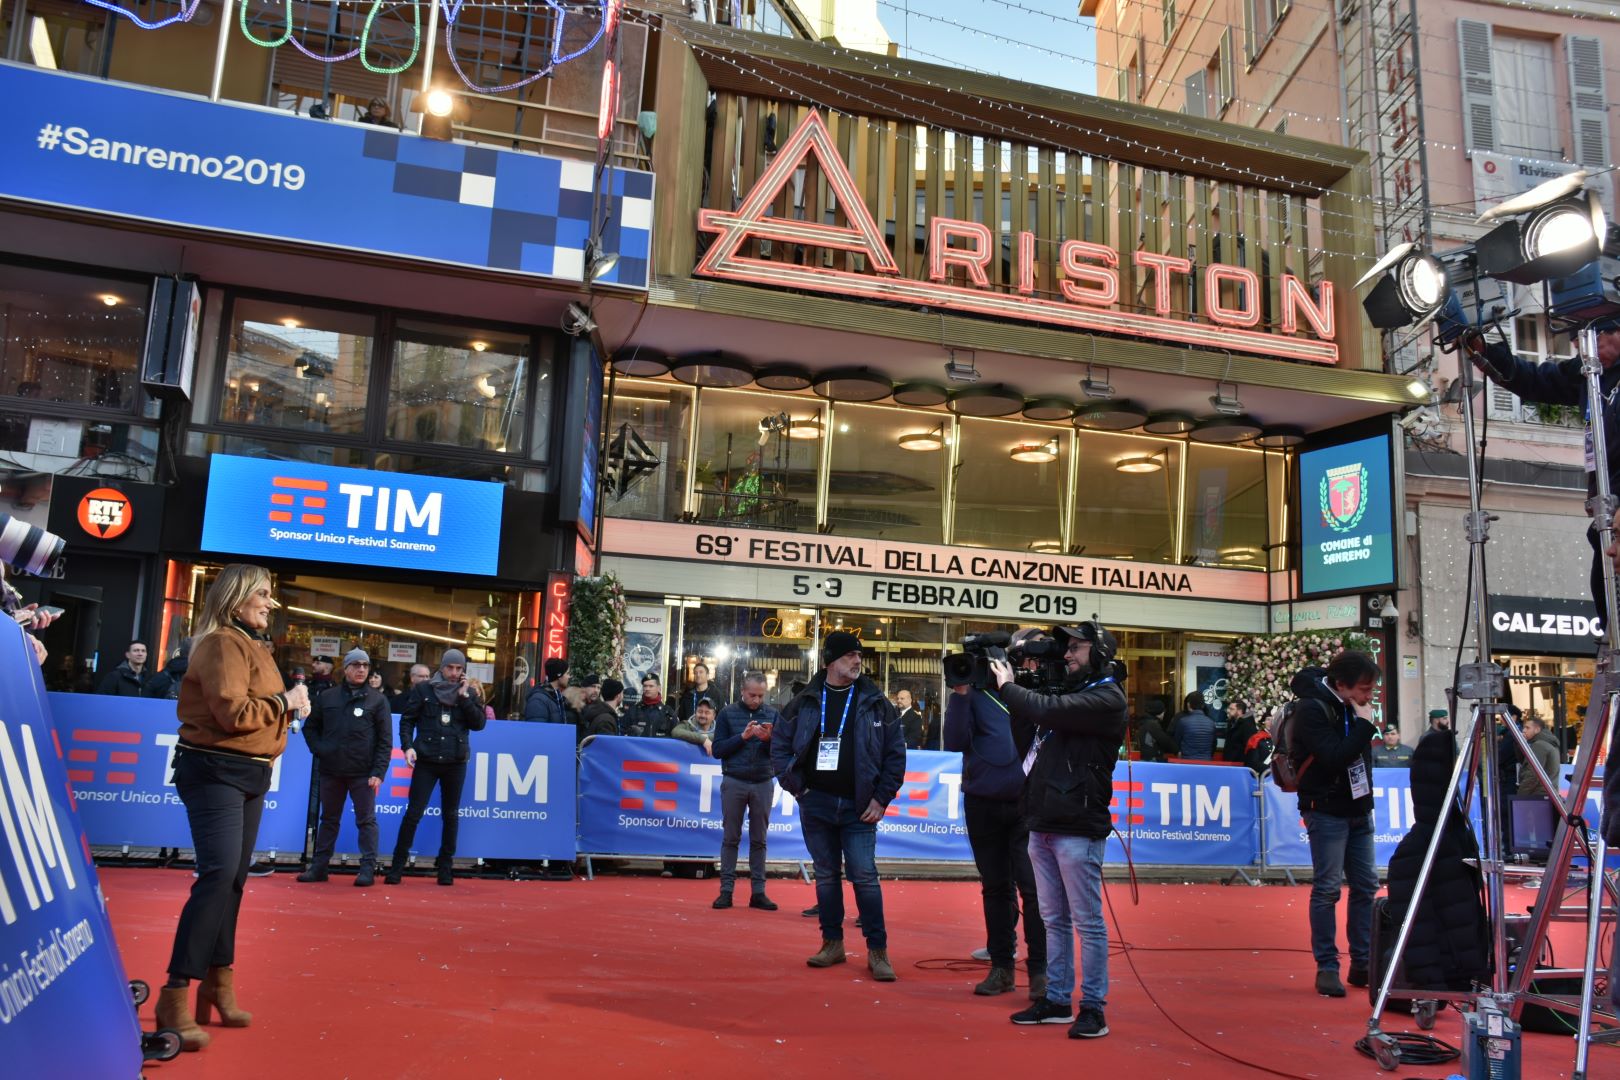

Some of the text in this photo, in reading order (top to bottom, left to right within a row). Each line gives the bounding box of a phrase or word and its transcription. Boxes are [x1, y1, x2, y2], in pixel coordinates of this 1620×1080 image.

[37, 123, 306, 191] #Sanremo2019
[694, 107, 1336, 343] ARISTON
[88, 499, 123, 516] RTL
[88, 514, 123, 526] 102.5
[339, 483, 443, 536] TIM
[269, 528, 436, 552] Sponsor Unico Festival Sanremo
[1320, 535, 1373, 553] COMUNE di
[748, 538, 872, 568] FESTIVAL
[884, 549, 964, 575] DELLA
[970, 556, 1084, 585] CANZONE
[1091, 566, 1193, 593] ITALIANA
[1323, 548, 1370, 565] SANREMO
[871, 580, 999, 610] FEBBRAIO
[1019, 593, 1077, 616] 2019
[549, 582, 567, 658] CINEM
[1492, 611, 1604, 637] CALZEDO
[474, 752, 549, 804] IM
[71, 790, 118, 802] ponsor
[121, 790, 161, 805] Unico
[1151, 782, 1231, 828] TIM
[0, 719, 77, 925] IM
[457, 807, 490, 818] stival
[492, 807, 548, 820] Sanremo
[618, 814, 663, 829] Sponsor
[666, 816, 699, 829] Unico
[700, 817, 724, 830] Fest
[878, 822, 969, 836] Sponsor Unico Fest
[1136, 828, 1161, 840] Unico
[1162, 829, 1193, 841] Festival
[1193, 830, 1231, 842] Sanremo
[1373, 833, 1403, 843] estival
[20, 930, 68, 996] Festival
[55, 917, 95, 966] Sanremo
